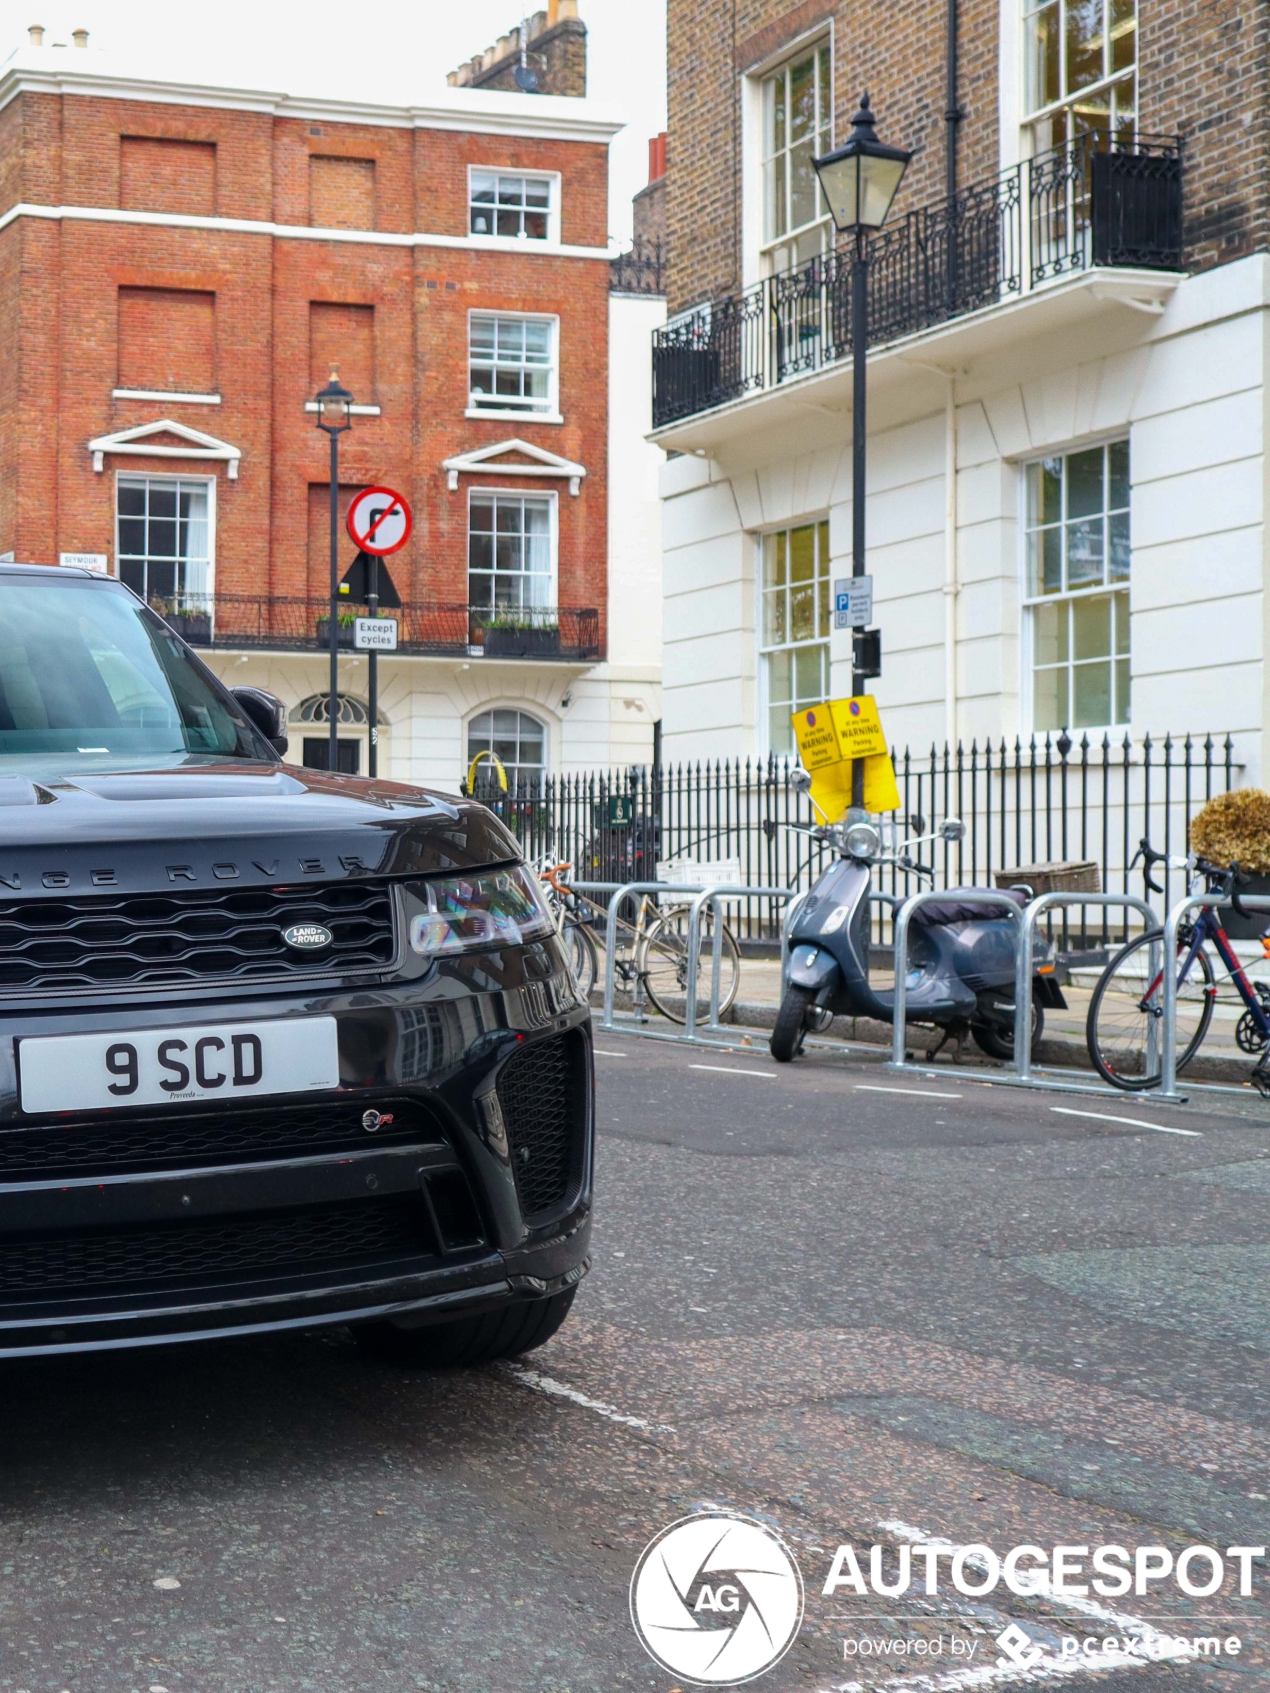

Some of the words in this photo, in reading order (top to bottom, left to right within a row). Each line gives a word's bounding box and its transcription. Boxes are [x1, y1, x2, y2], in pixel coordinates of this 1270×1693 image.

[65, 556, 98, 564] SEYMOUR
[360, 622, 393, 633] Except
[361, 635, 392, 645] cycles
[840, 724, 879, 739] WARNING
[801, 732, 833, 751] WARNING
[853, 738, 872, 746] Parking
[165, 855, 368, 882] ROVER
[293, 928, 317, 936] LAND
[297, 935, 325, 944] ROVER
[105, 1043, 139, 1096] 9
[157, 1033, 263, 1092] SCD
[170, 1090, 195, 1099] Proveeda
